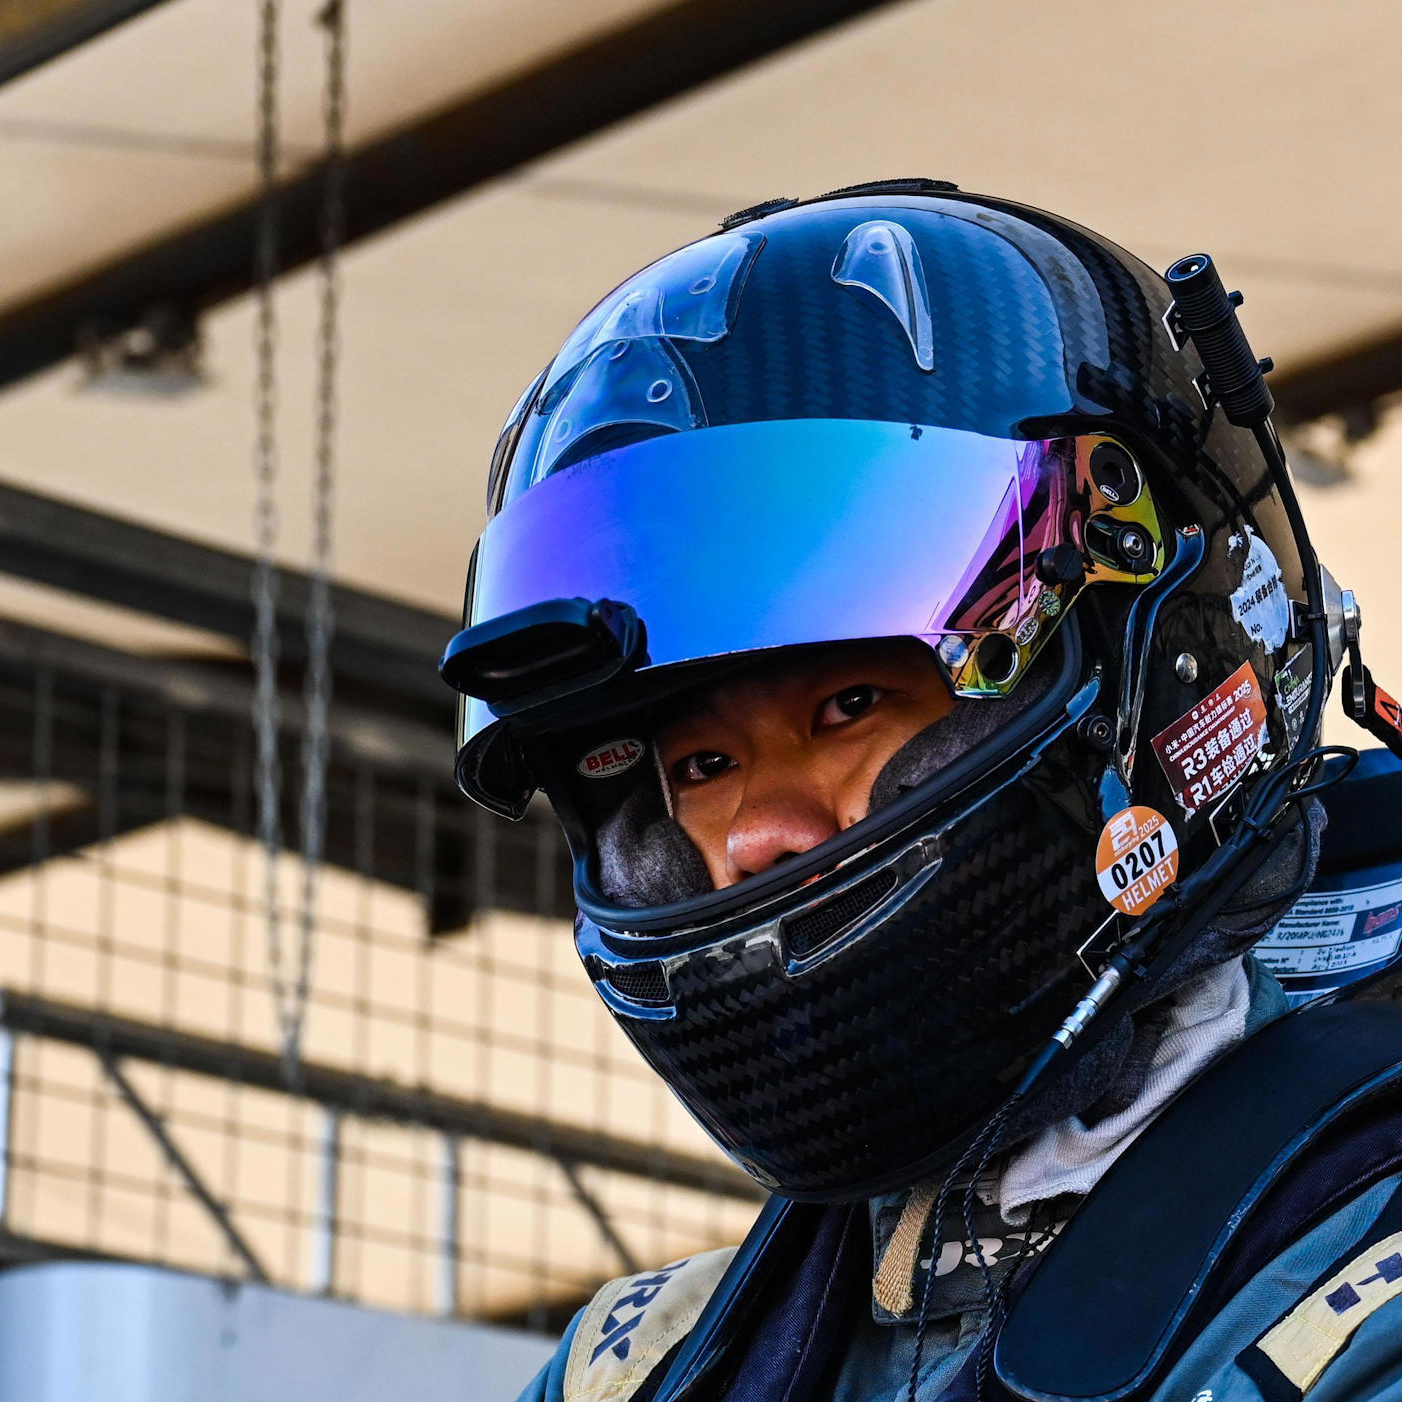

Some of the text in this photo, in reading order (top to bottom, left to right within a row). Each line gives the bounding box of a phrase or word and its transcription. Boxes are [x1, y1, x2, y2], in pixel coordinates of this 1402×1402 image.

[1238, 596, 1255, 616] 2024
[1251, 623, 1263, 636] No.
[1233, 679, 1251, 702] 2025
[586, 743, 637, 771] BELL
[1138, 815, 1160, 837] 2025
[1111, 830, 1165, 890] 0207
[1122, 858, 1175, 911] HELMET
